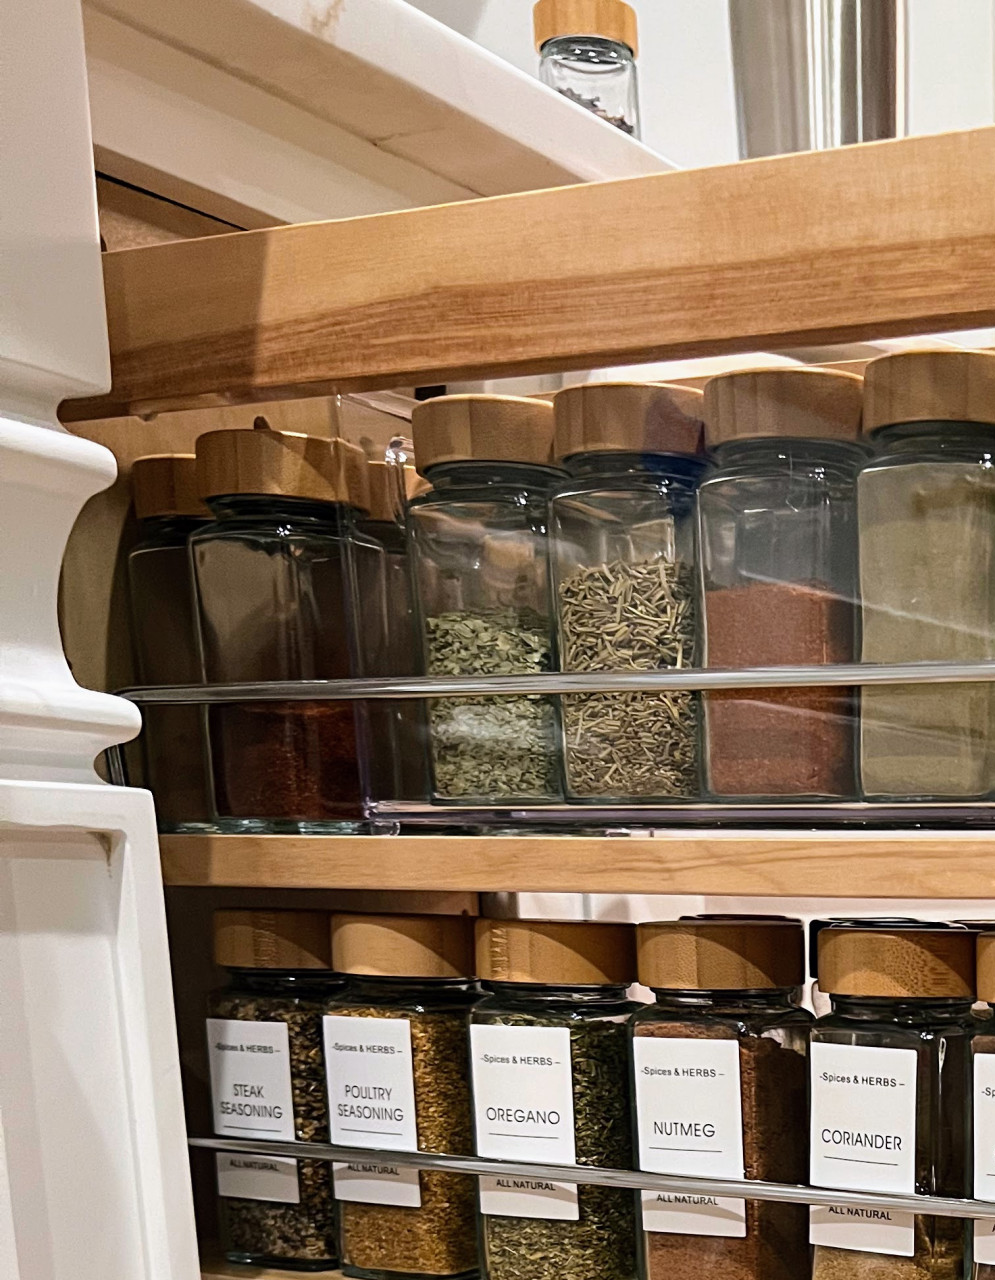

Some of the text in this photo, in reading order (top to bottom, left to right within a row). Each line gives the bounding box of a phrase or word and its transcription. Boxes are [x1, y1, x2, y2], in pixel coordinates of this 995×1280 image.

[246, 1045, 273, 1054] HERBS
[366, 1045, 395, 1054] HERBS
[520, 1057, 553, 1067] HERBS
[682, 1069, 716, 1078] HERBS
[861, 1076, 897, 1088] HERBS
[233, 1084, 265, 1098] STEAK
[345, 1085, 393, 1101] POULTRY
[220, 1104, 283, 1119] SEASONING
[337, 1104, 404, 1122] SEASONING
[486, 1107, 561, 1125] OREGANO
[653, 1121, 716, 1138] NUTMEG
[821, 1128, 902, 1151] CORIANDER
[496, 1178, 556, 1191] ALL NATURAL
[657, 1194, 719, 1206] ALL NATURAL
[828, 1205, 892, 1221] ALL NATURAL
